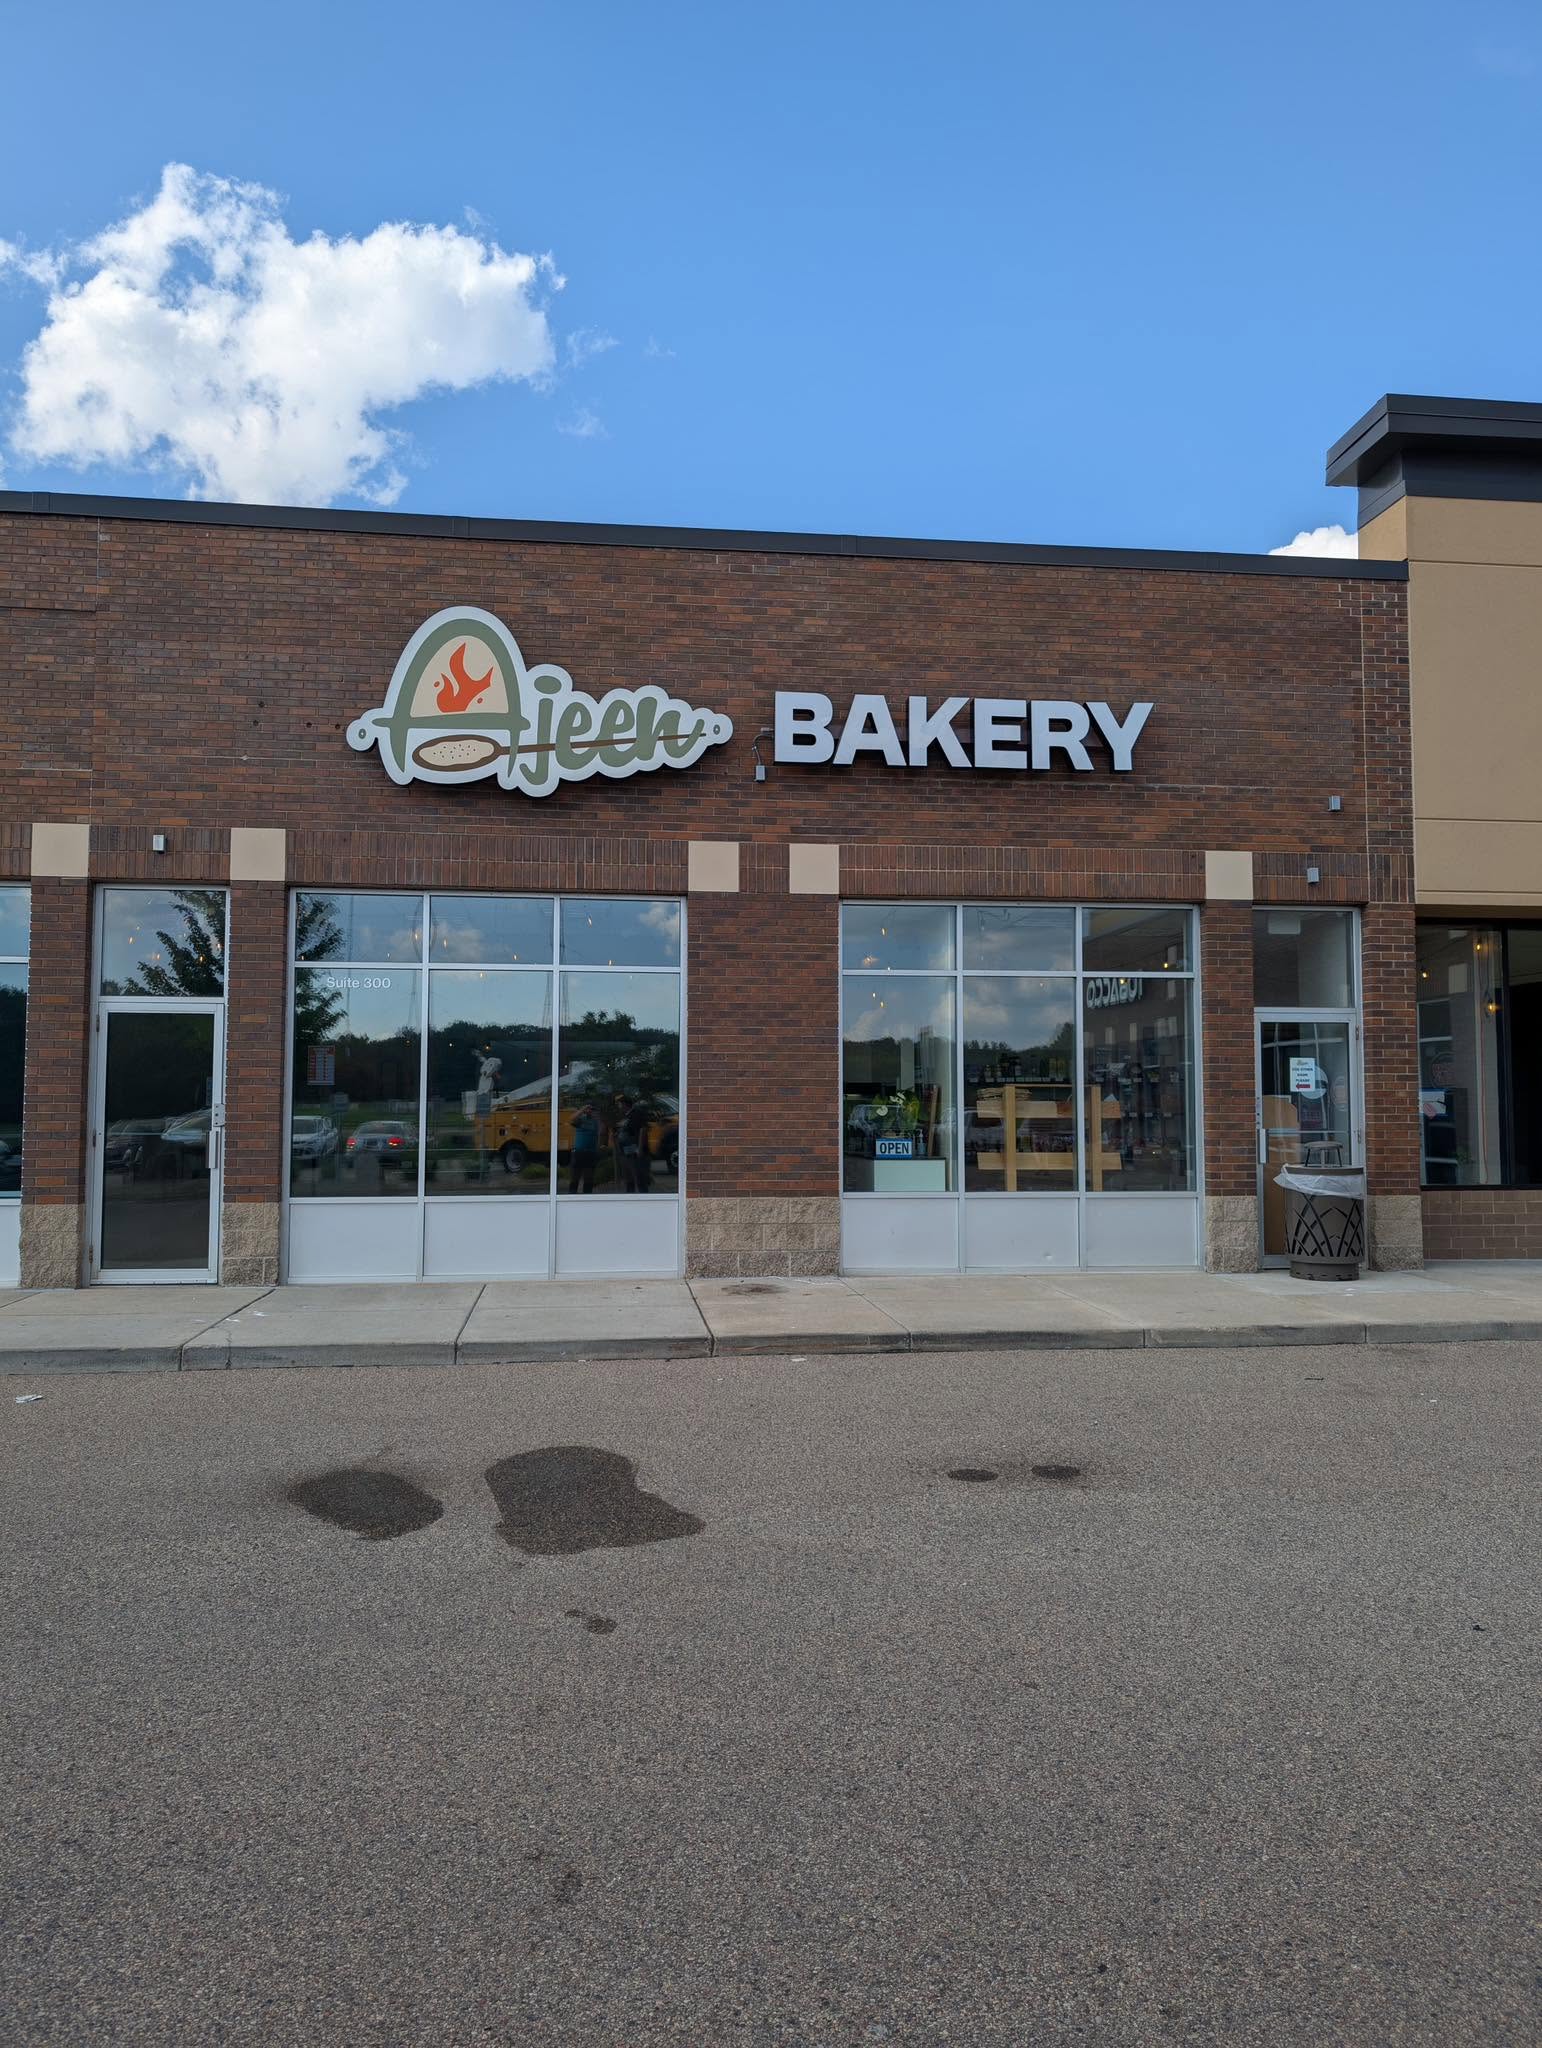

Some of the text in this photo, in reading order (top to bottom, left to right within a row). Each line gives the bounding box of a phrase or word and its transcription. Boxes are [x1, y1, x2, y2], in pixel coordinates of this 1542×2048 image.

[371, 617, 1155, 786] Ajeen BAKERY
[327, 976, 391, 989] Suite 300
[879, 1142, 910, 1154] OPEN
